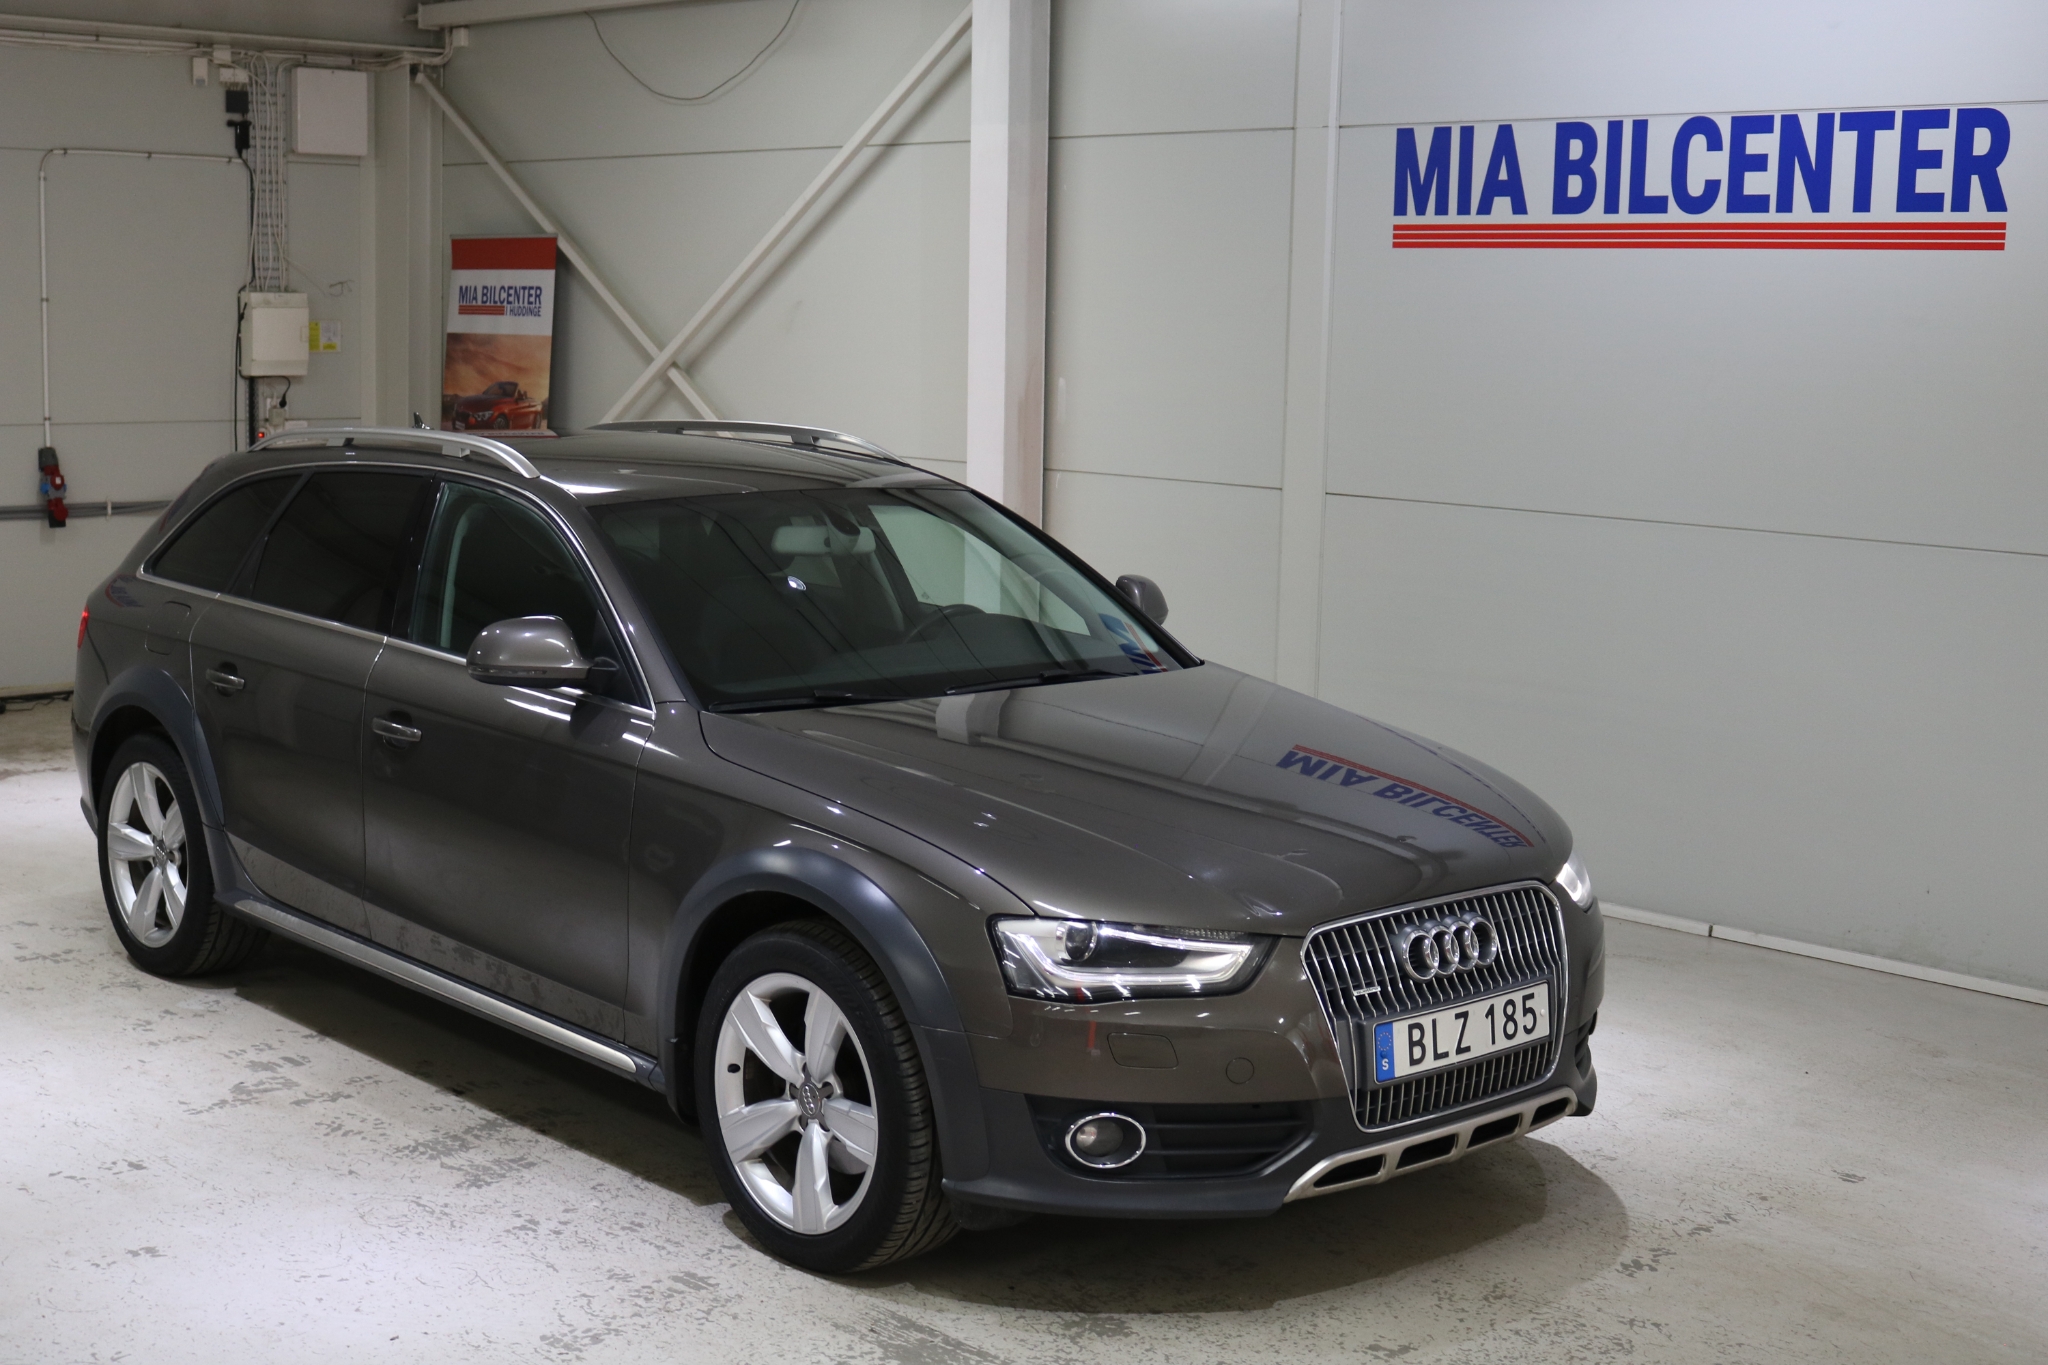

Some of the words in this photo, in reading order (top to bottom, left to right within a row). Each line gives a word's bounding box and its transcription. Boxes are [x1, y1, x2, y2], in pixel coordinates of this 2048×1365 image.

[1393, 124, 1529, 216] MIA
[1552, 107, 2011, 215] BILCENTER
[459, 285, 478, 304] MIA
[481, 285, 543, 305] BILCENTER
[509, 306, 542, 317] HUDDINGE
[1407, 1010, 1471, 1067] BLZ
[1485, 992, 1538, 1046] 185
[1381, 1058, 1390, 1071] S
